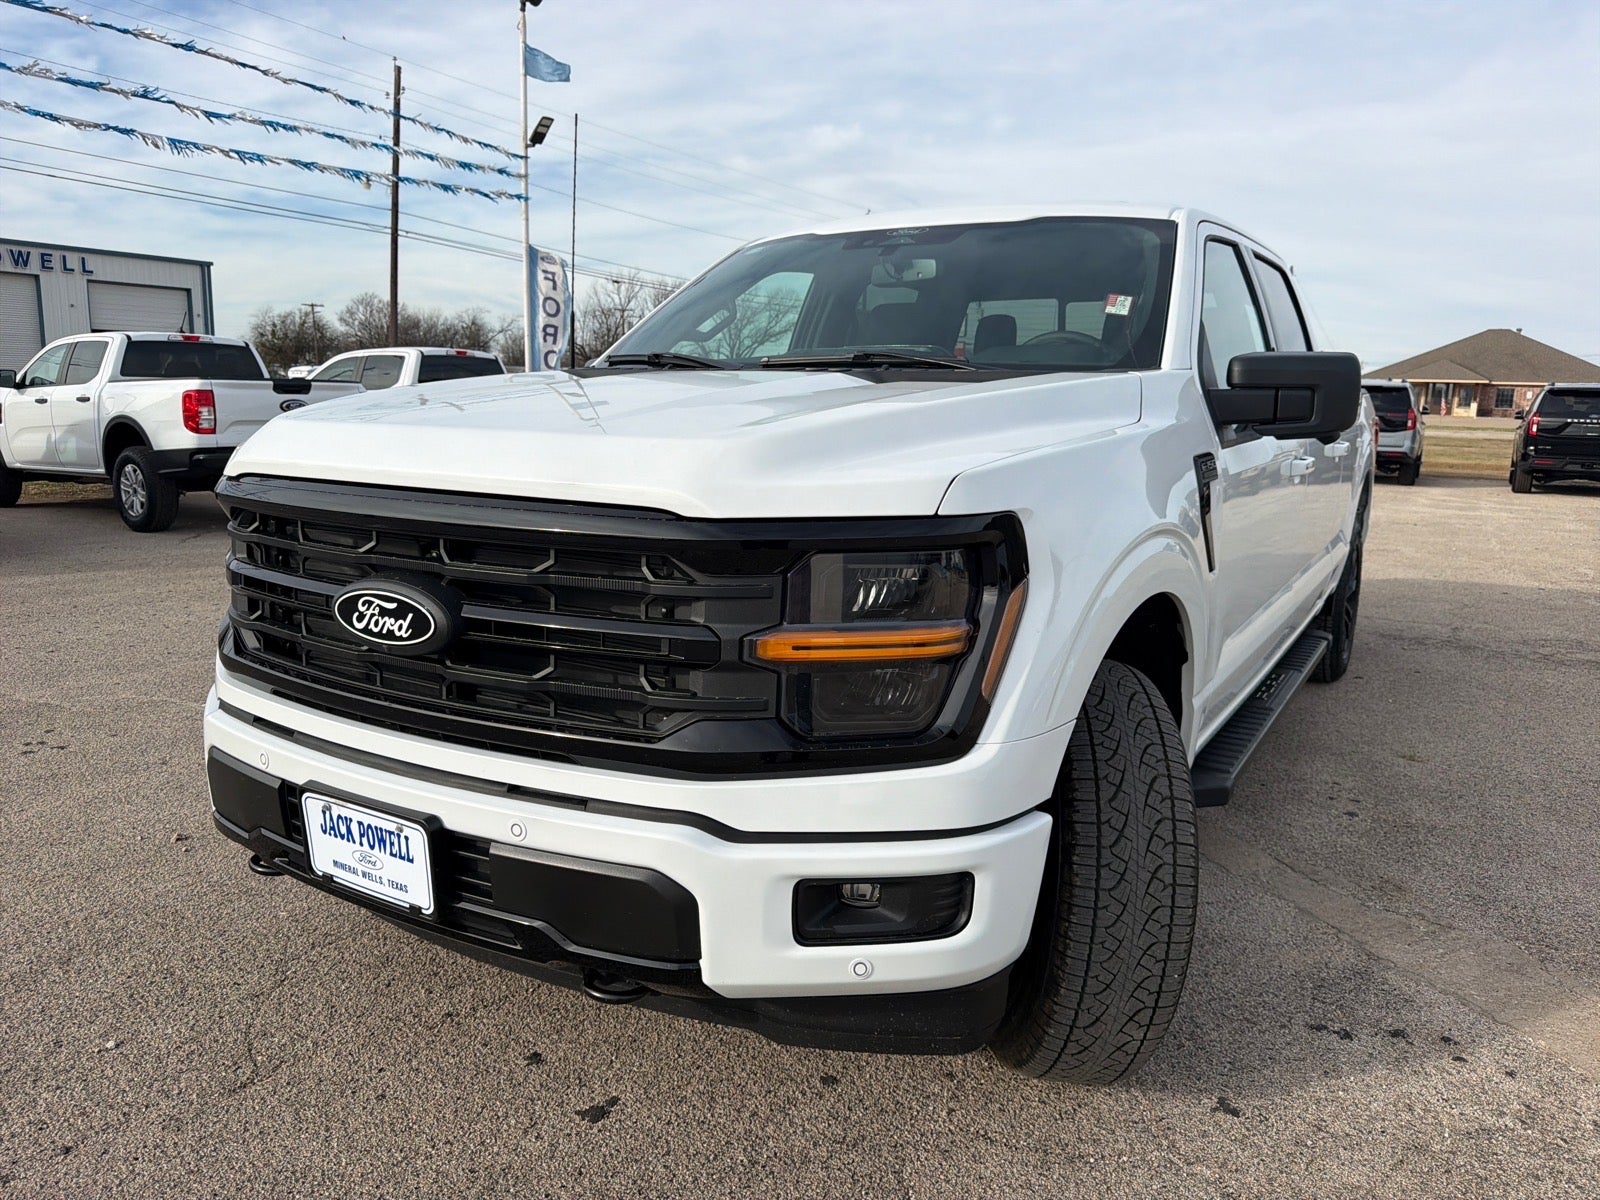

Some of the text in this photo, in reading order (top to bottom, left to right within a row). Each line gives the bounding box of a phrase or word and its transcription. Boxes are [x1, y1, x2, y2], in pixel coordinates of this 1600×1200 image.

[0, 248, 94, 274] WELL
[352, 596, 414, 638] Ford
[320, 808, 415, 864] JACK POWELL
[332, 859, 409, 894] MINERAL WELLS, TEXAS
[358, 852, 378, 868] Ford
